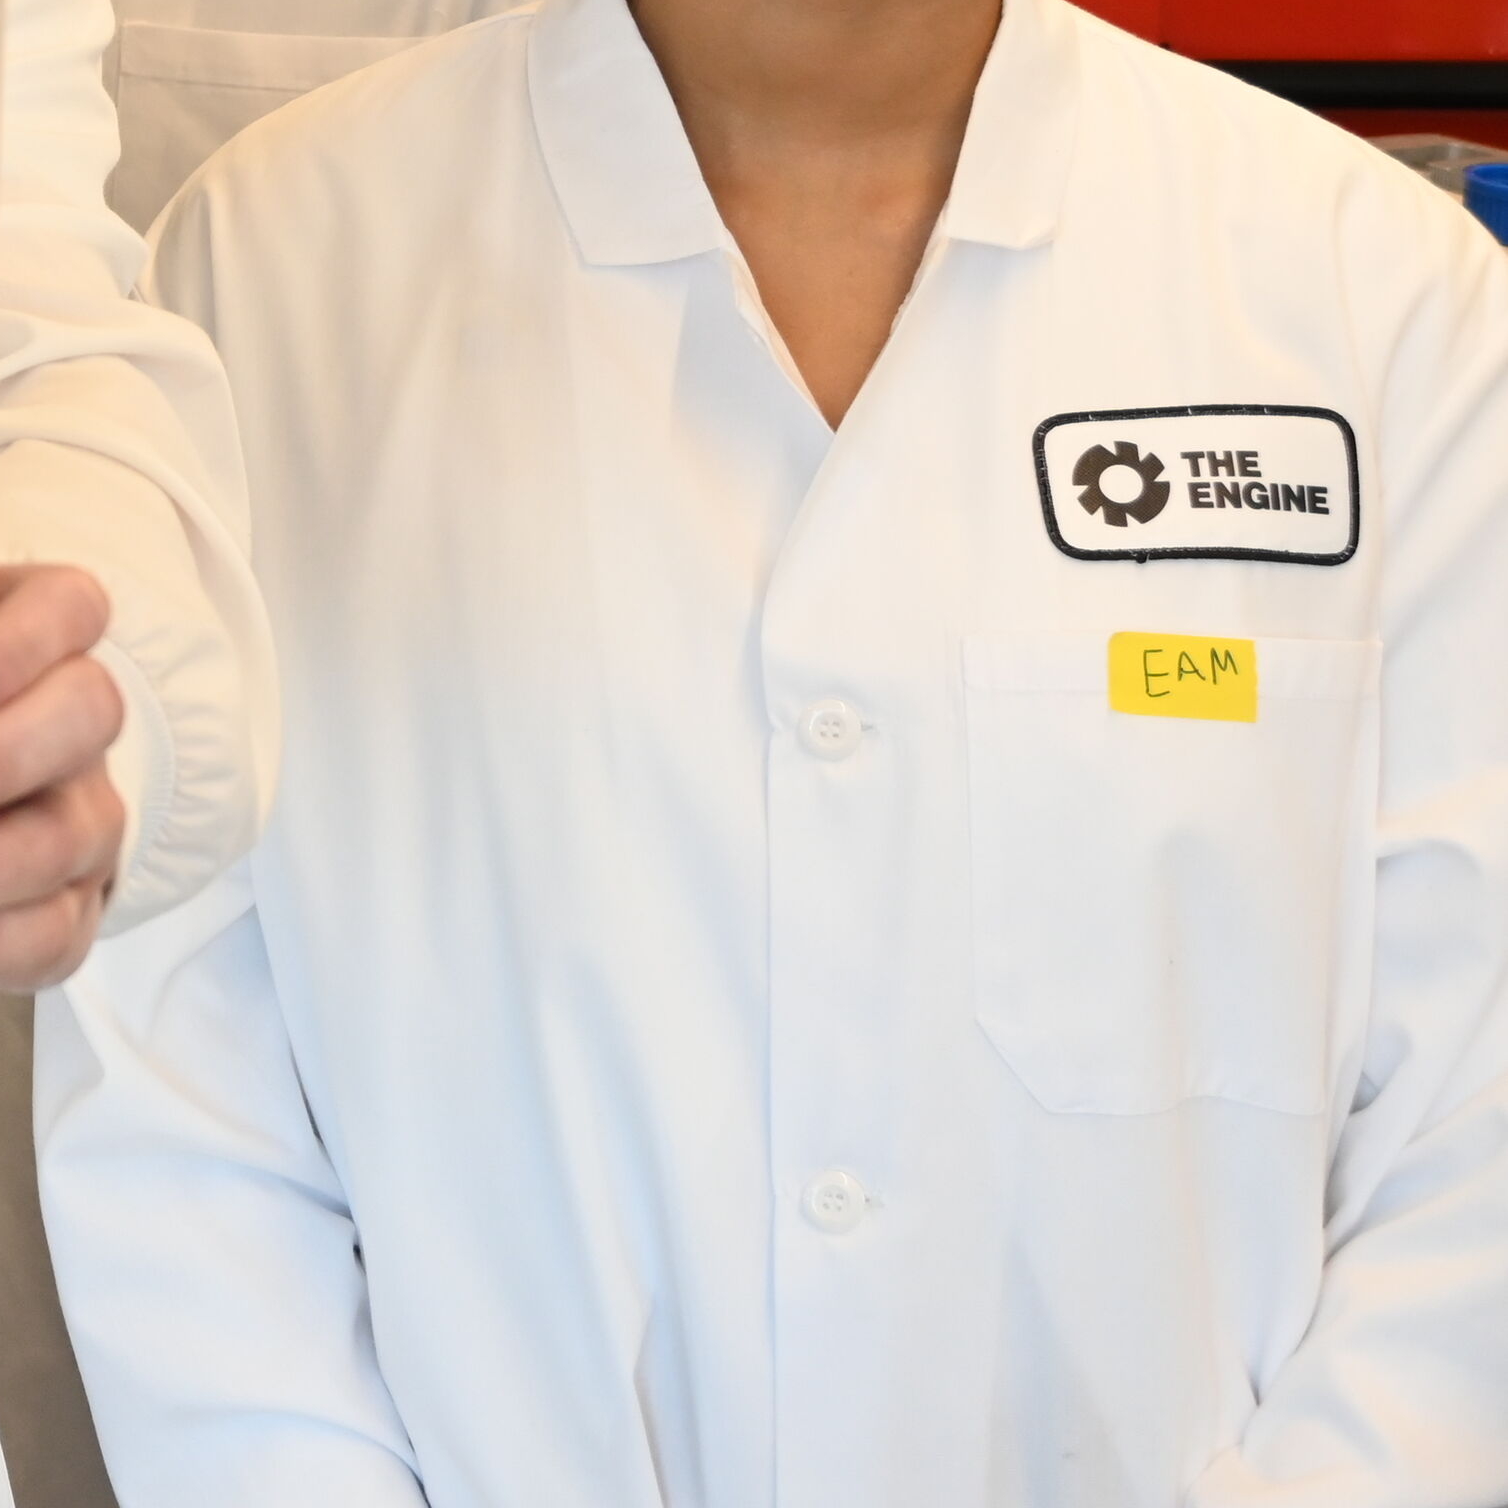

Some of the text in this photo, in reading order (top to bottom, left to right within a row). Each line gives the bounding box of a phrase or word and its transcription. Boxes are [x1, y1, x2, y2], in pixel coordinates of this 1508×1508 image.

[1180, 450, 1262, 477] THE
[1187, 481, 1329, 515] ENGINE
[1143, 647, 1238, 698] EAM
